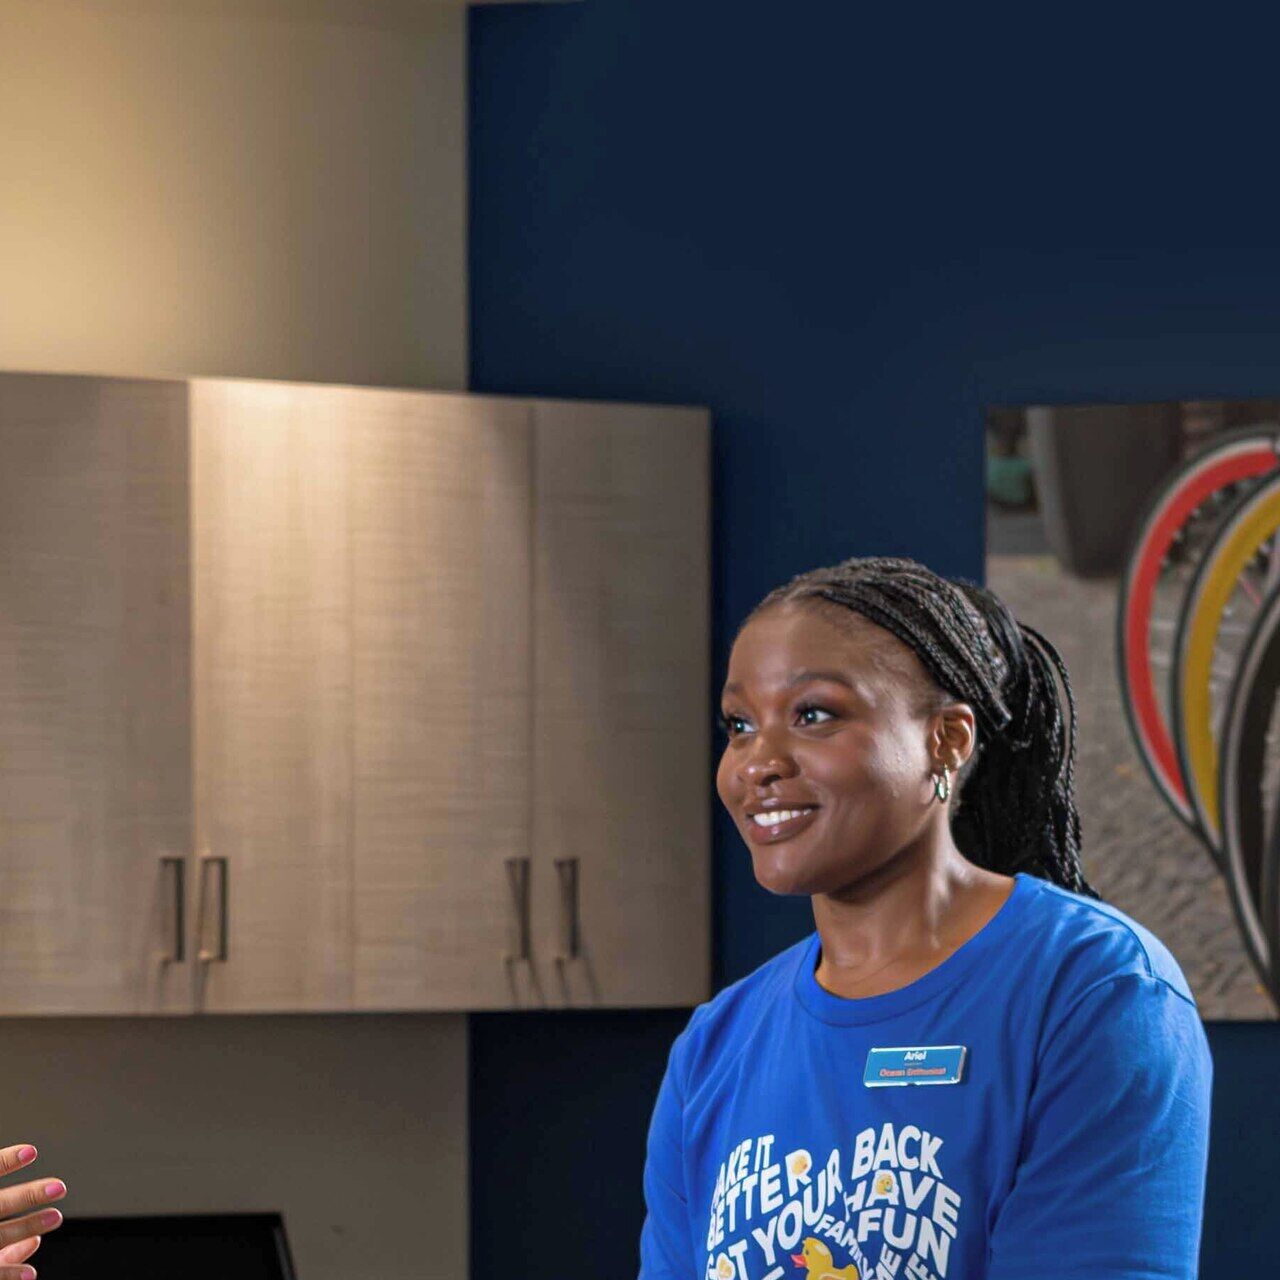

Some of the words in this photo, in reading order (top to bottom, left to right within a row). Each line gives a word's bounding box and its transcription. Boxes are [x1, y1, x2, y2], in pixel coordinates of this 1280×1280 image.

[754, 1134, 775, 1173] IT
[851, 1122, 944, 1180] BACK
[707, 1149, 813, 1251] BETTER
[751, 1149, 843, 1267] YOUR
[843, 1169, 962, 1240] HAVE
[857, 1207, 951, 1279] FUN
